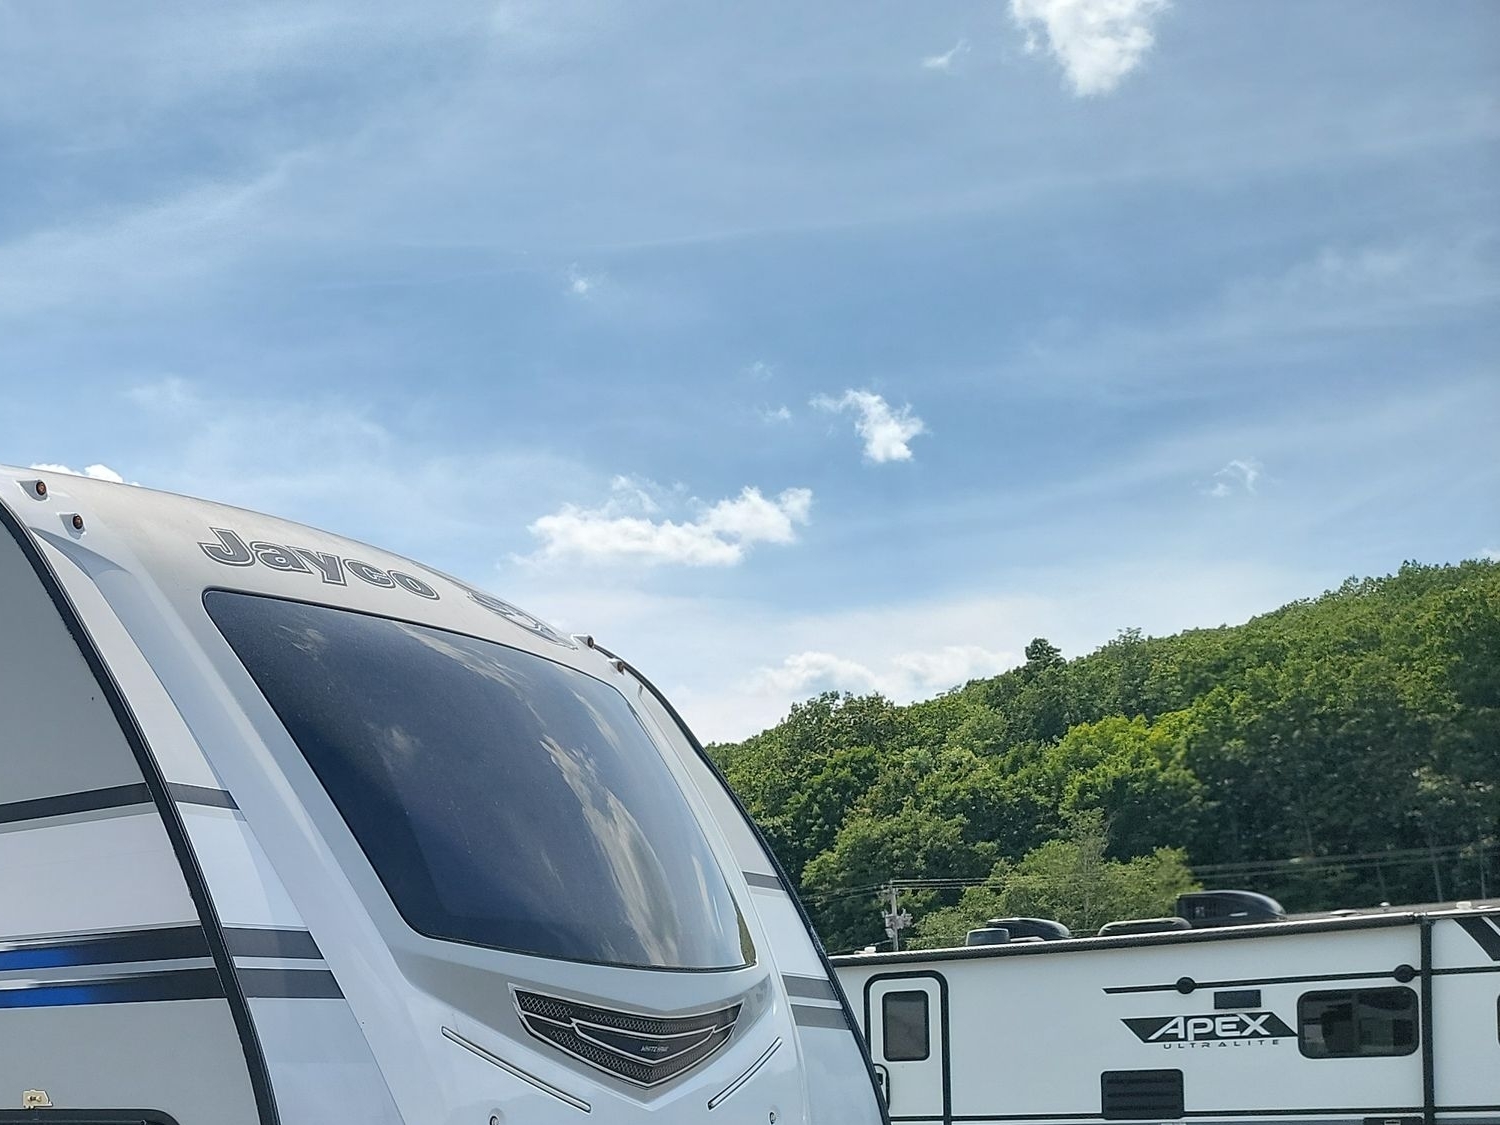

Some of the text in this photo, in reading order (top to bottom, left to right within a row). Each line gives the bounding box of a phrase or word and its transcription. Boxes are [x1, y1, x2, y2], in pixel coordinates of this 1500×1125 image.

[197, 526, 441, 600] Jayco
[1147, 1013, 1271, 1041] APEX
[1163, 1039, 1280, 1050] ULTRALITE
